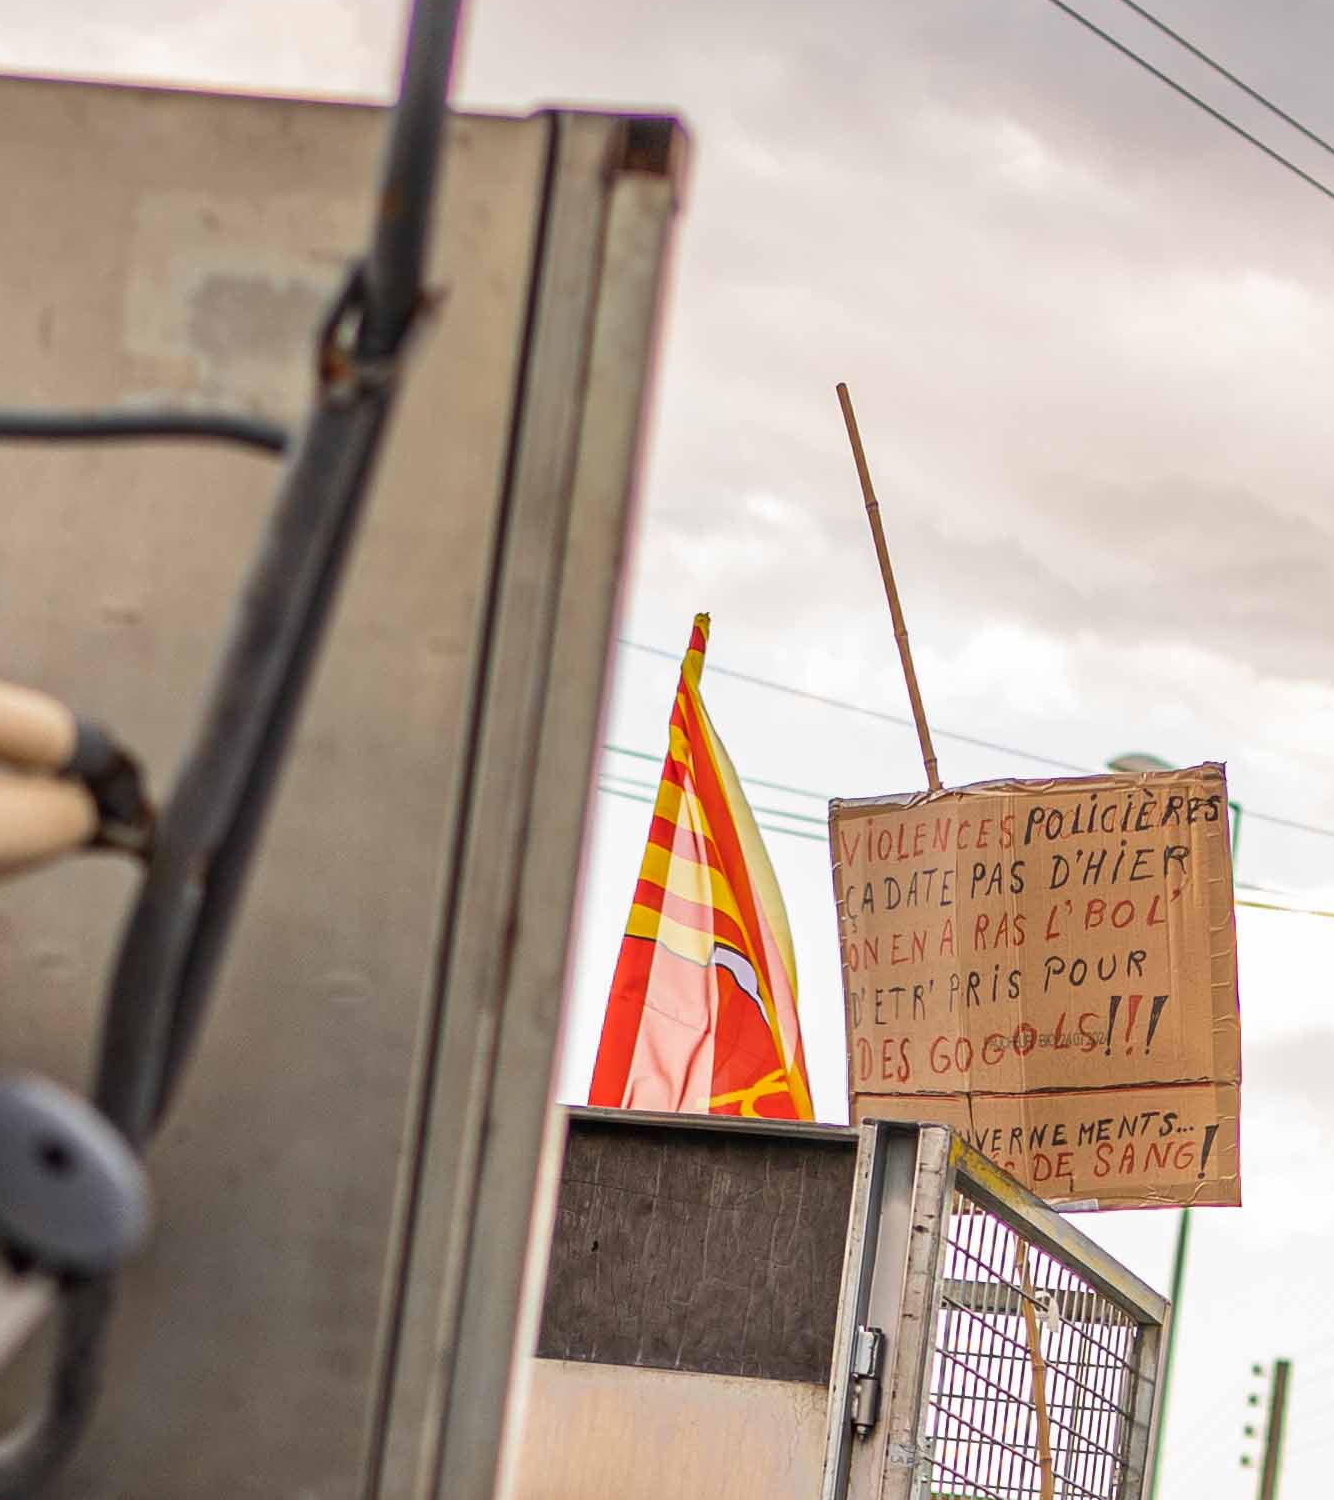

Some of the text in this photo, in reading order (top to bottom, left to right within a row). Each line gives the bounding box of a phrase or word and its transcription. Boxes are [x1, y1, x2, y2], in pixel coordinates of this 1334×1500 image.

[841, 788, 1221, 868] VIOLENCES POLICIÈRES
[971, 861, 1026, 899] PAS
[1050, 839, 1190, 889] D'HIER
[975, 912, 1027, 950] RAS
[950, 964, 1022, 1012] PRIS
[1044, 950, 1147, 993] POUR
[857, 1037, 912, 1082] DES
